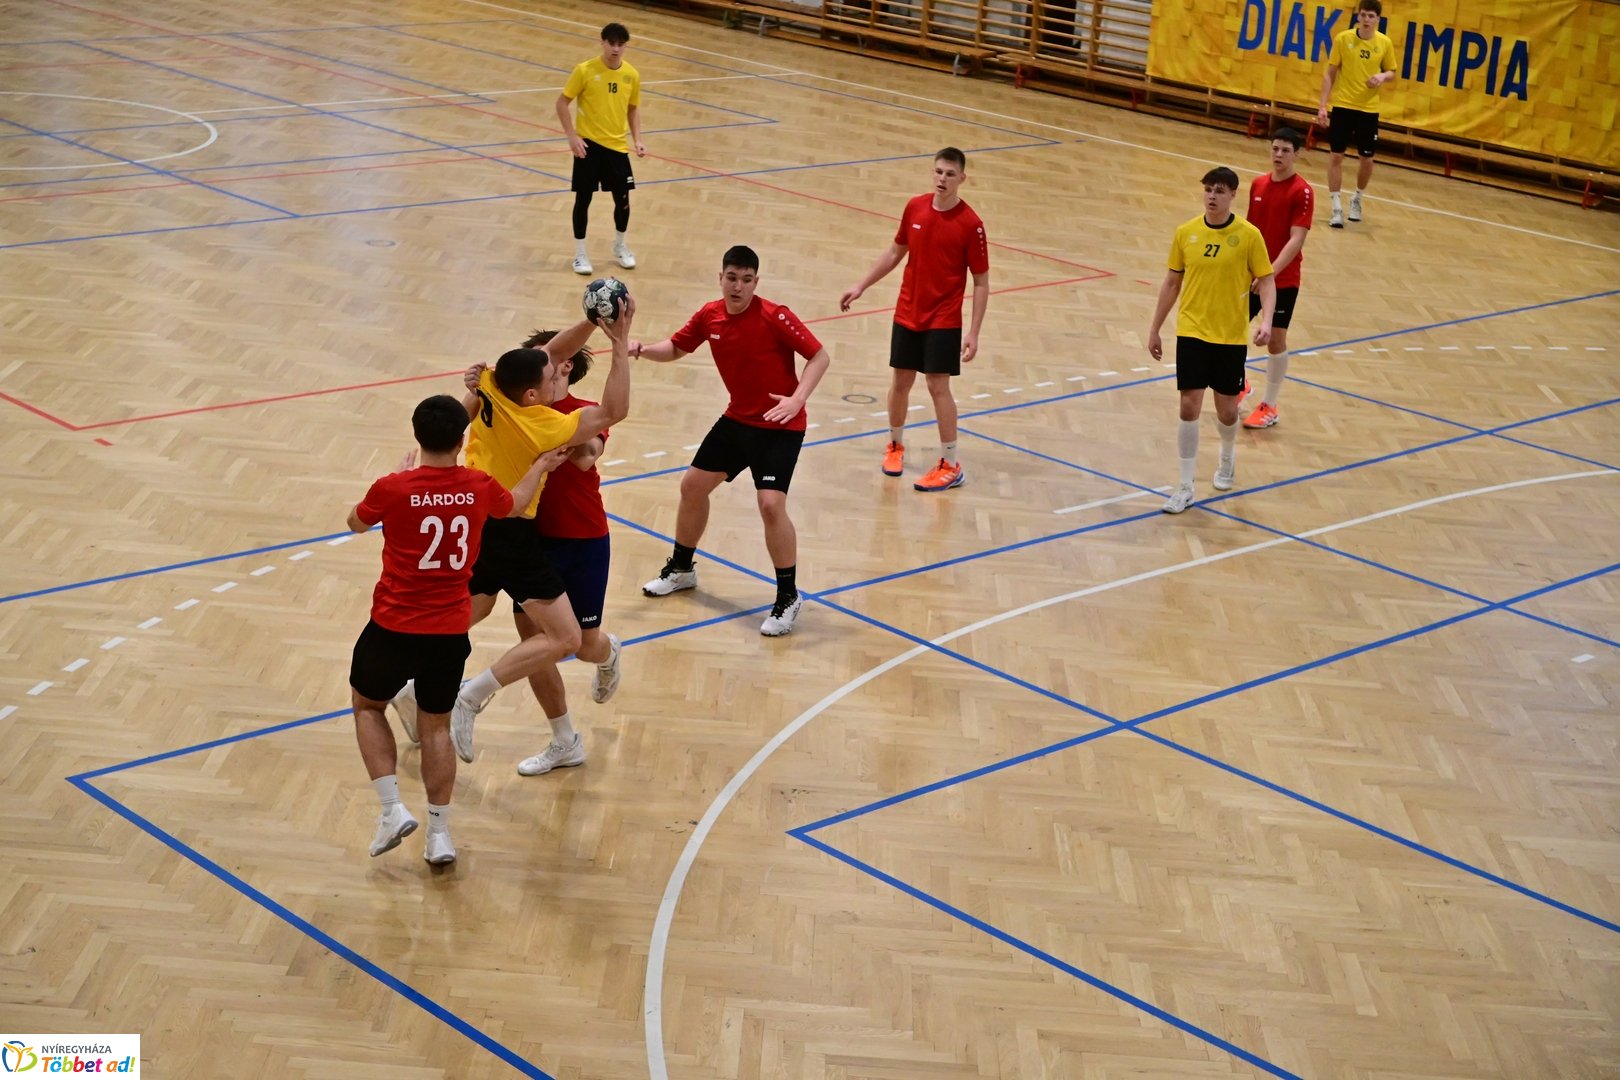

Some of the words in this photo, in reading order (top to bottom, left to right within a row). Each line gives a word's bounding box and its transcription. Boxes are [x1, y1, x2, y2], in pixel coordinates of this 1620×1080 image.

[1360, 49, 1370, 59] 33
[608, 82, 618, 94] 18
[1203, 243, 1221, 258] 27
[410, 491, 475, 507] BÁRDOS
[418, 515, 469, 571] 23
